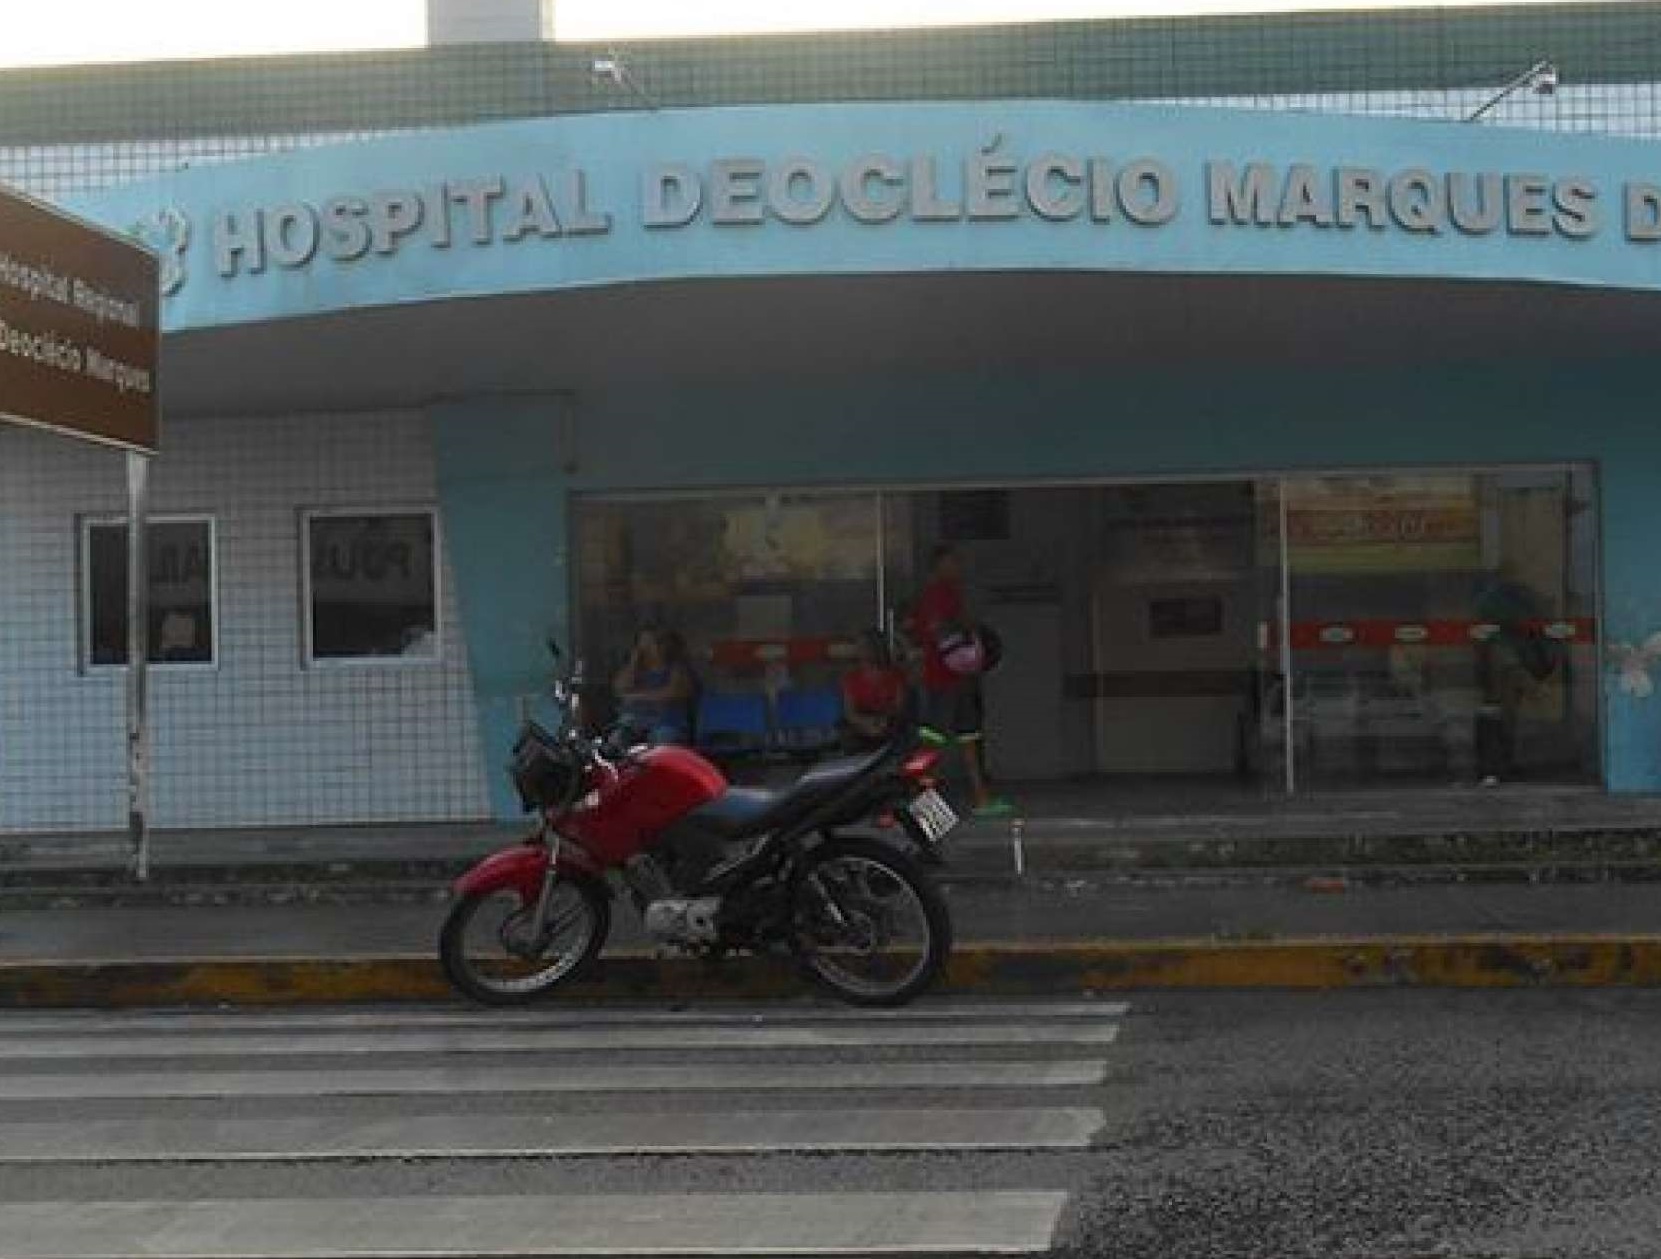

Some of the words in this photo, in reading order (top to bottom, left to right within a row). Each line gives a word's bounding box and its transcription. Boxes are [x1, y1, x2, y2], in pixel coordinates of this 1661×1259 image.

[213, 168, 611, 278] HOSPITAL
[643, 132, 1180, 231] DEOCLÉCIO
[1206, 160, 1598, 241] MARQUES
